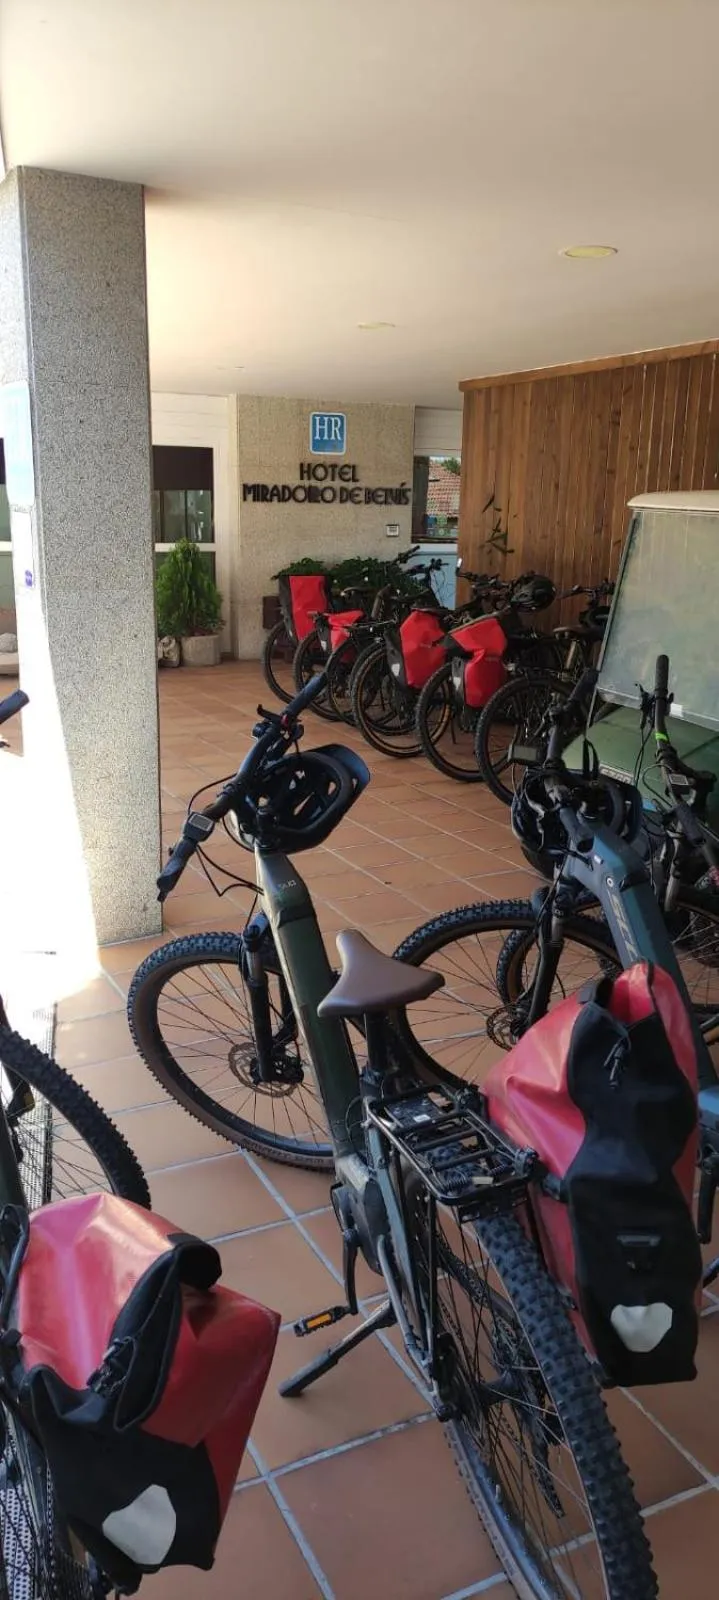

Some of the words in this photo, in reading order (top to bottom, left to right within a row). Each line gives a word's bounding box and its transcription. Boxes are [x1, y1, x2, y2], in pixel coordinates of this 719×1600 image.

[314, 416, 342, 440] HR
[300, 463, 360, 482] HOTEL
[340, 487, 363, 504] DE
